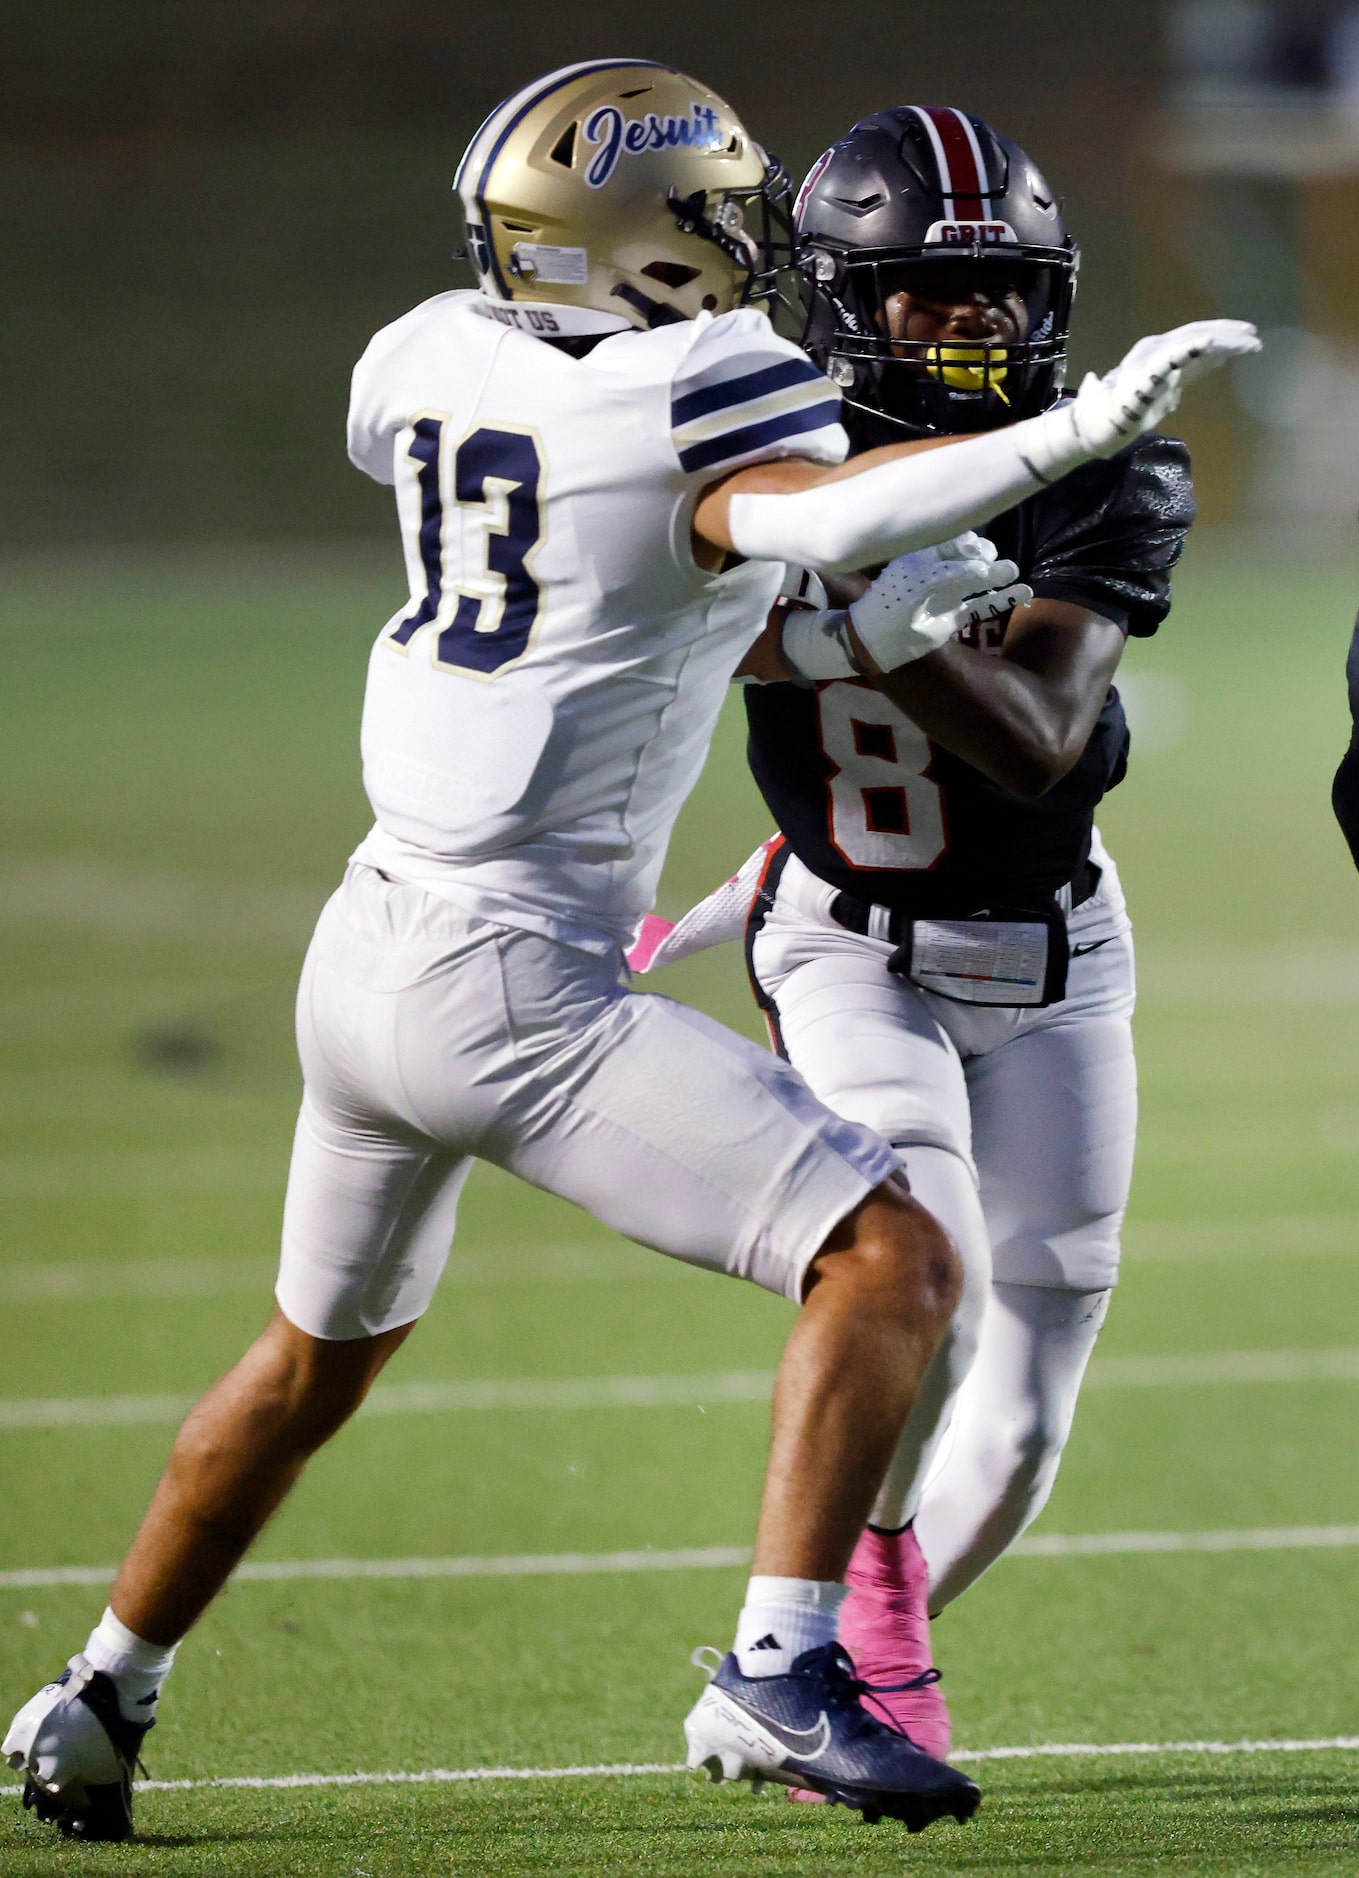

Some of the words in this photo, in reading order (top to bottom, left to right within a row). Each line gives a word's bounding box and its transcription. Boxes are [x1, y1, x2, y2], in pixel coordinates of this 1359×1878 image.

[583, 104, 724, 189] Jesuit
[941, 224, 1005, 243] GRIT
[523, 309, 560, 332] US
[383, 408, 549, 683] 13
[817, 678, 950, 872] 8
